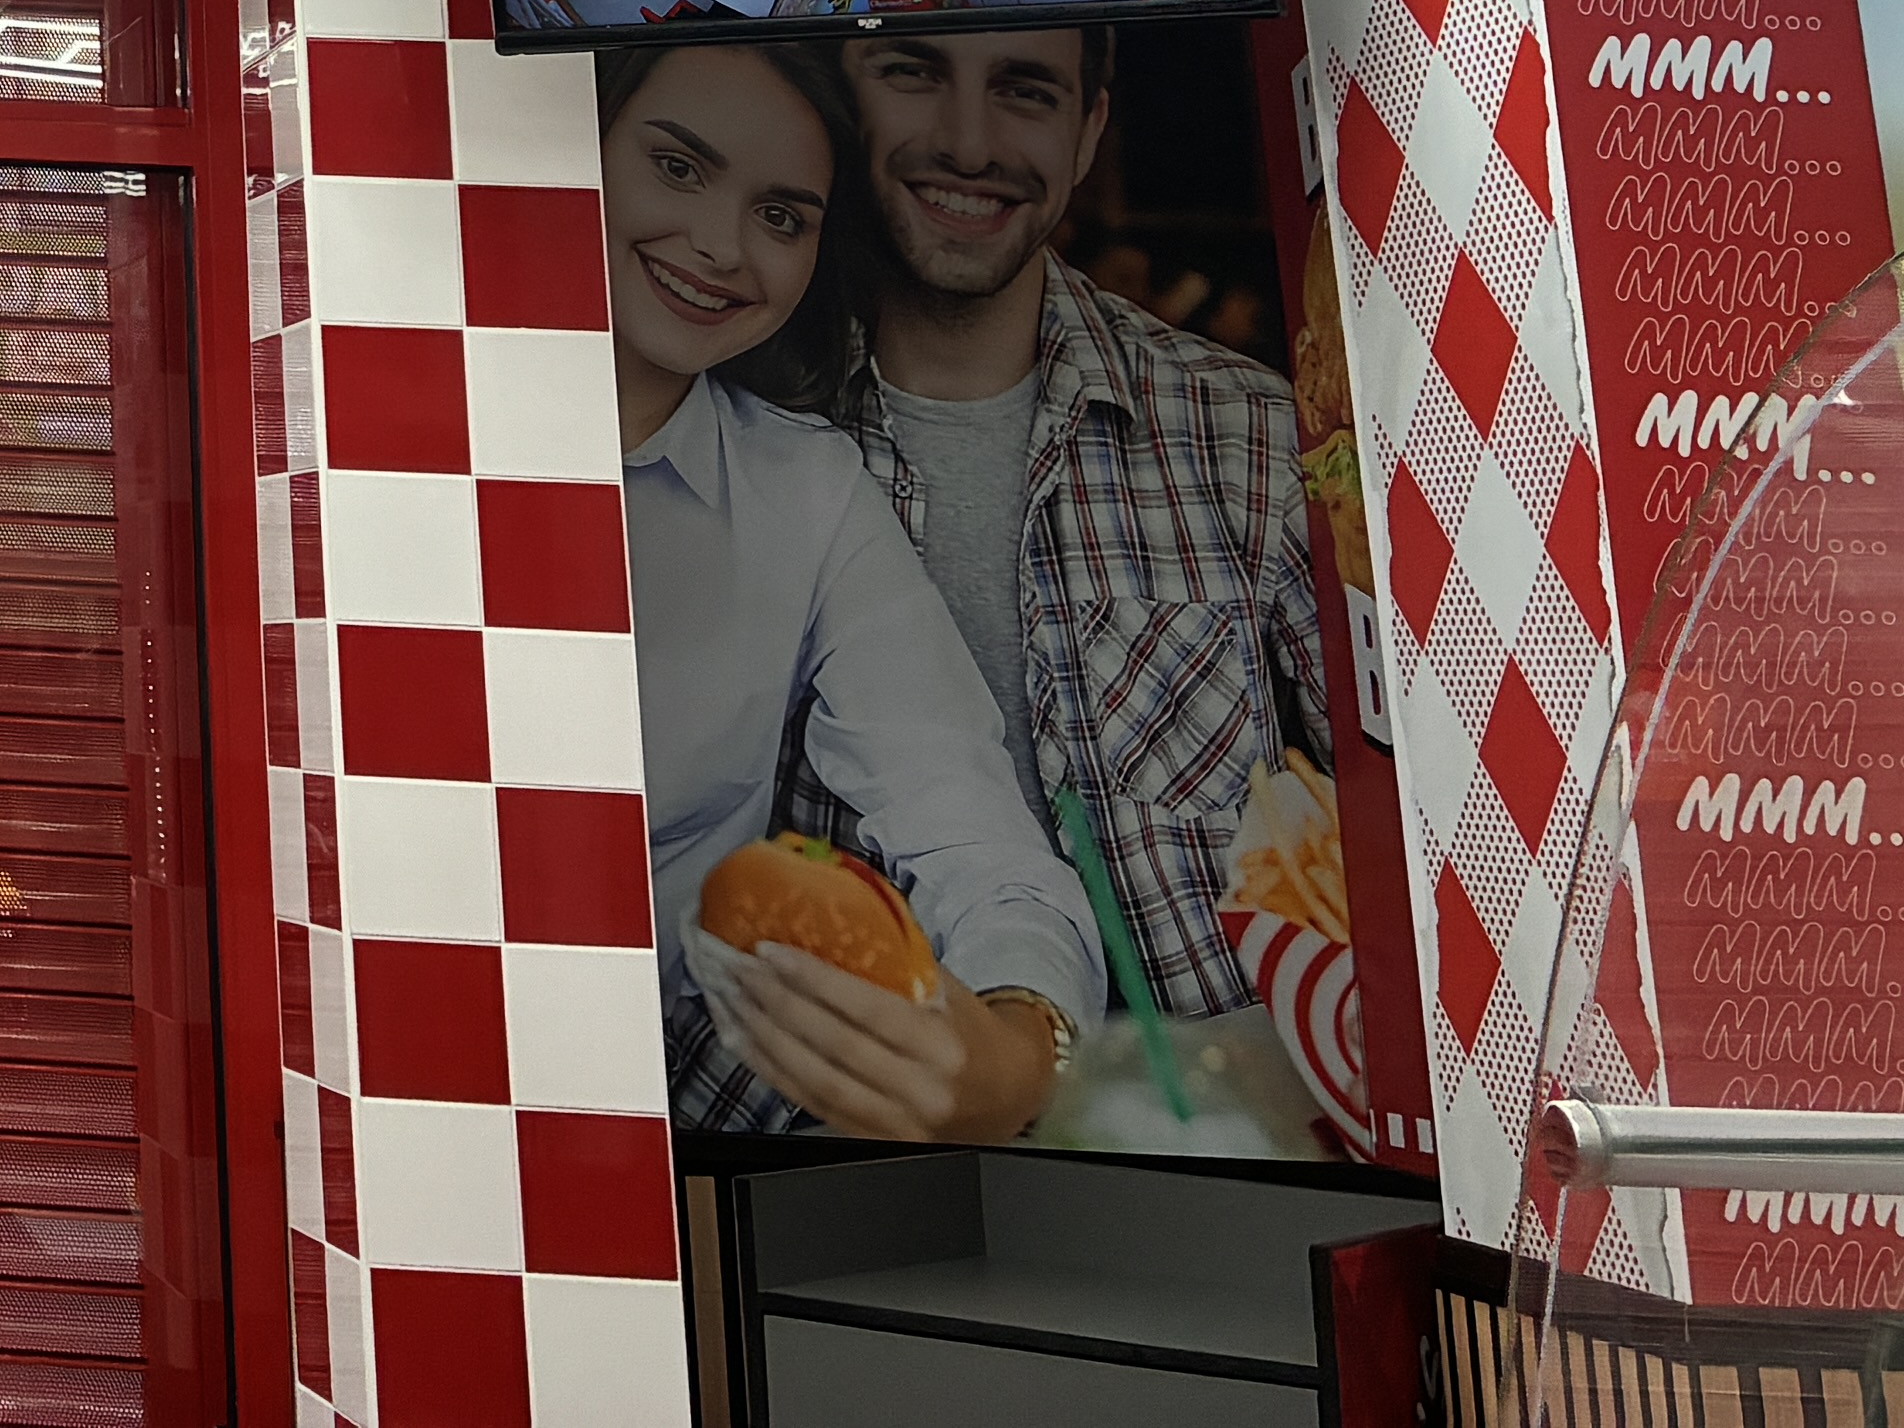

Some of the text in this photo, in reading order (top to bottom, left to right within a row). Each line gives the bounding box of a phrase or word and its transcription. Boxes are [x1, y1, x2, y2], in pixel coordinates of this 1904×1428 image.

[1588, 33, 1831, 104] MMM...
[1597, 102, 1841, 175] MMM...
[1606, 172, 1850, 245] MMM...
[1616, 243, 1856, 317] MMM...
[1665, 693, 1904, 768] MMM..
